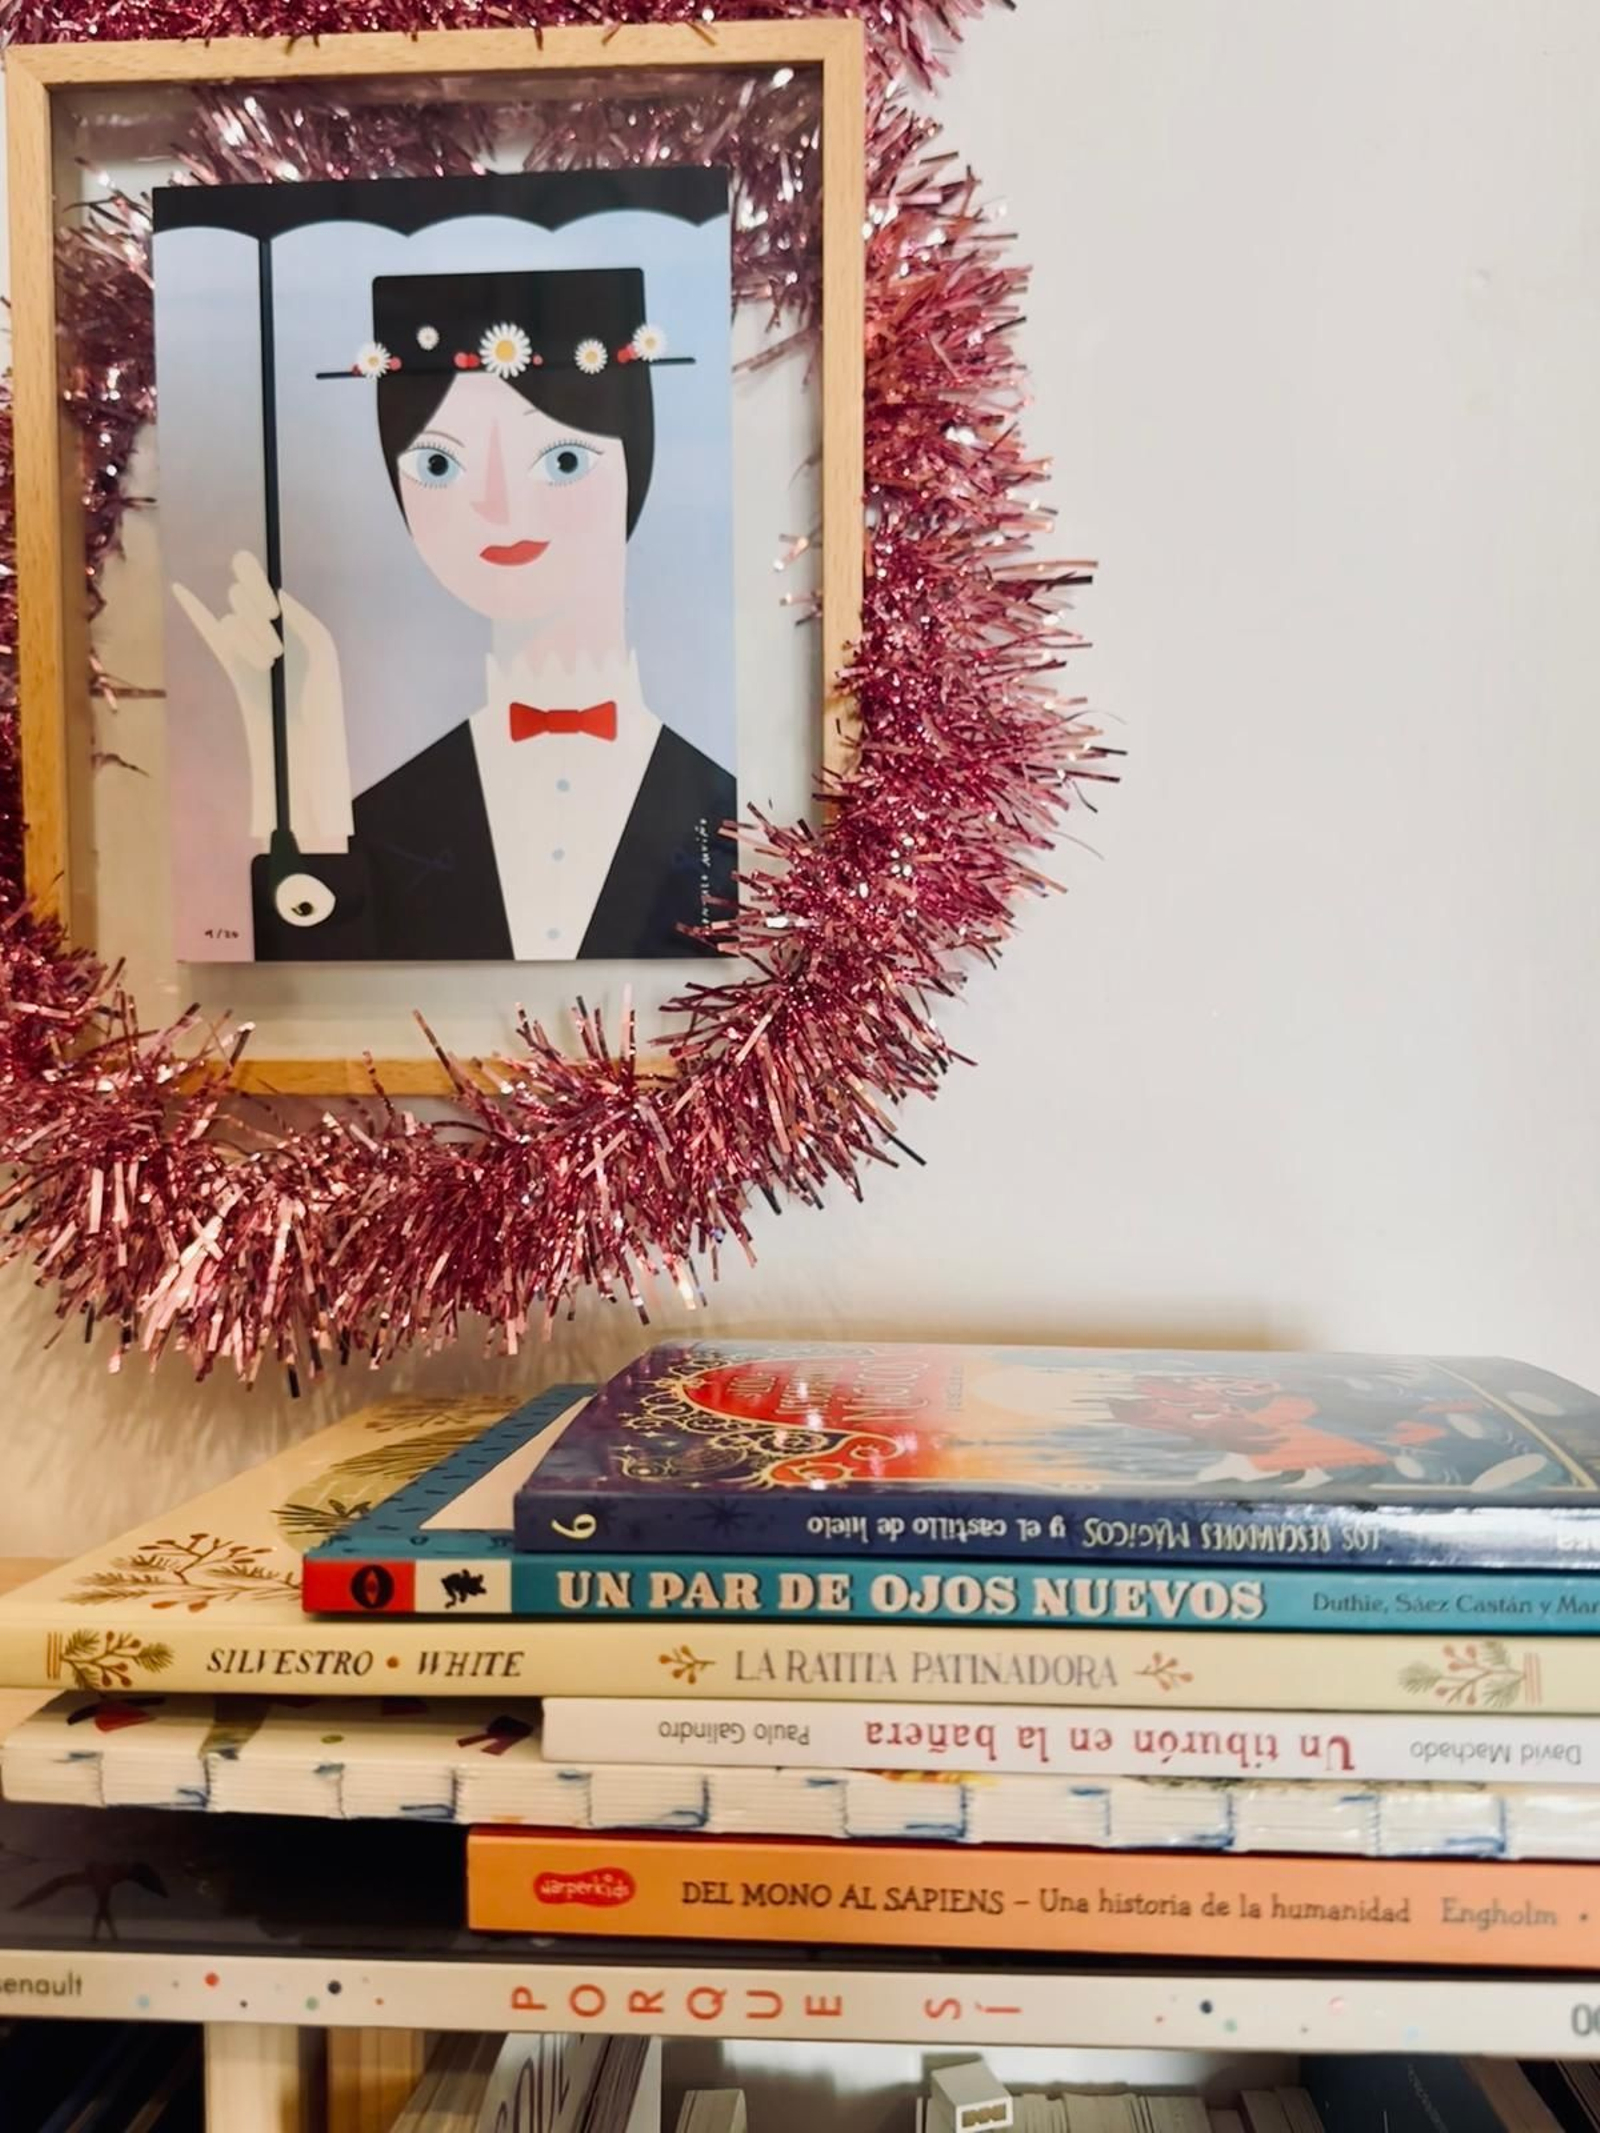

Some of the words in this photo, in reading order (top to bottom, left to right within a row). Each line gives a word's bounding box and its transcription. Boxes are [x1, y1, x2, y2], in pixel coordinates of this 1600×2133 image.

[806, 1516, 868, 1543] hielo
[877, 1516, 904, 1541] de
[912, 1516, 1006, 1543] castillo
[1017, 1518, 1041, 1541] el
[1050, 1514, 1066, 1538] y
[1201, 1521, 1330, 1551] RESCATADORES
[1342, 1523, 1380, 1551] LOS
[557, 1571, 633, 1610] UN
[650, 1571, 763, 1611] PAR
[778, 1572, 853, 1611] DE
[870, 1573, 1019, 1615] OJOS
[1032, 1576, 1267, 1620] NUEVOS
[1312, 1591, 1389, 1614] Duthie,
[1395, 1593, 1450, 1613] Sáez
[1456, 1593, 1533, 1615] Castán
[1538, 1601, 1551, 1619] y
[206, 1647, 375, 1677] SILVESTRO
[418, 1650, 525, 1678] WHITE
[735, 1648, 776, 1681] LA
[785, 1649, 898, 1685] RATITA
[911, 1651, 1119, 1689] PATINADORA
[659, 1719, 746, 1745] Galindro
[753, 1720, 811, 1746] Paulo
[865, 1720, 998, 1761] bañera
[1018, 1724, 1051, 1762] la
[1068, 1726, 1112, 1752] en
[1134, 1729, 1280, 1770] tiburón
[1300, 1733, 1355, 1771] Un
[1411, 1738, 1512, 1766] Machado
[1521, 1742, 1583, 1766] David
[680, 1880, 735, 1905] DEL
[740, 1882, 833, 1907] MONO
[838, 1884, 877, 1910] AL
[883, 1886, 1005, 1915] SAPIENS
[1039, 1887, 1090, 1913] Una
[1097, 1888, 1192, 1917] historia
[1200, 1891, 1231, 1917] de
[1239, 1892, 1261, 1919] la
[1270, 1892, 1411, 1923] humanidad
[1440, 1896, 1558, 1931] Engholm
[0, 1968, 83, 1997] enault
[510, 1983, 843, 2021] PORQUE
